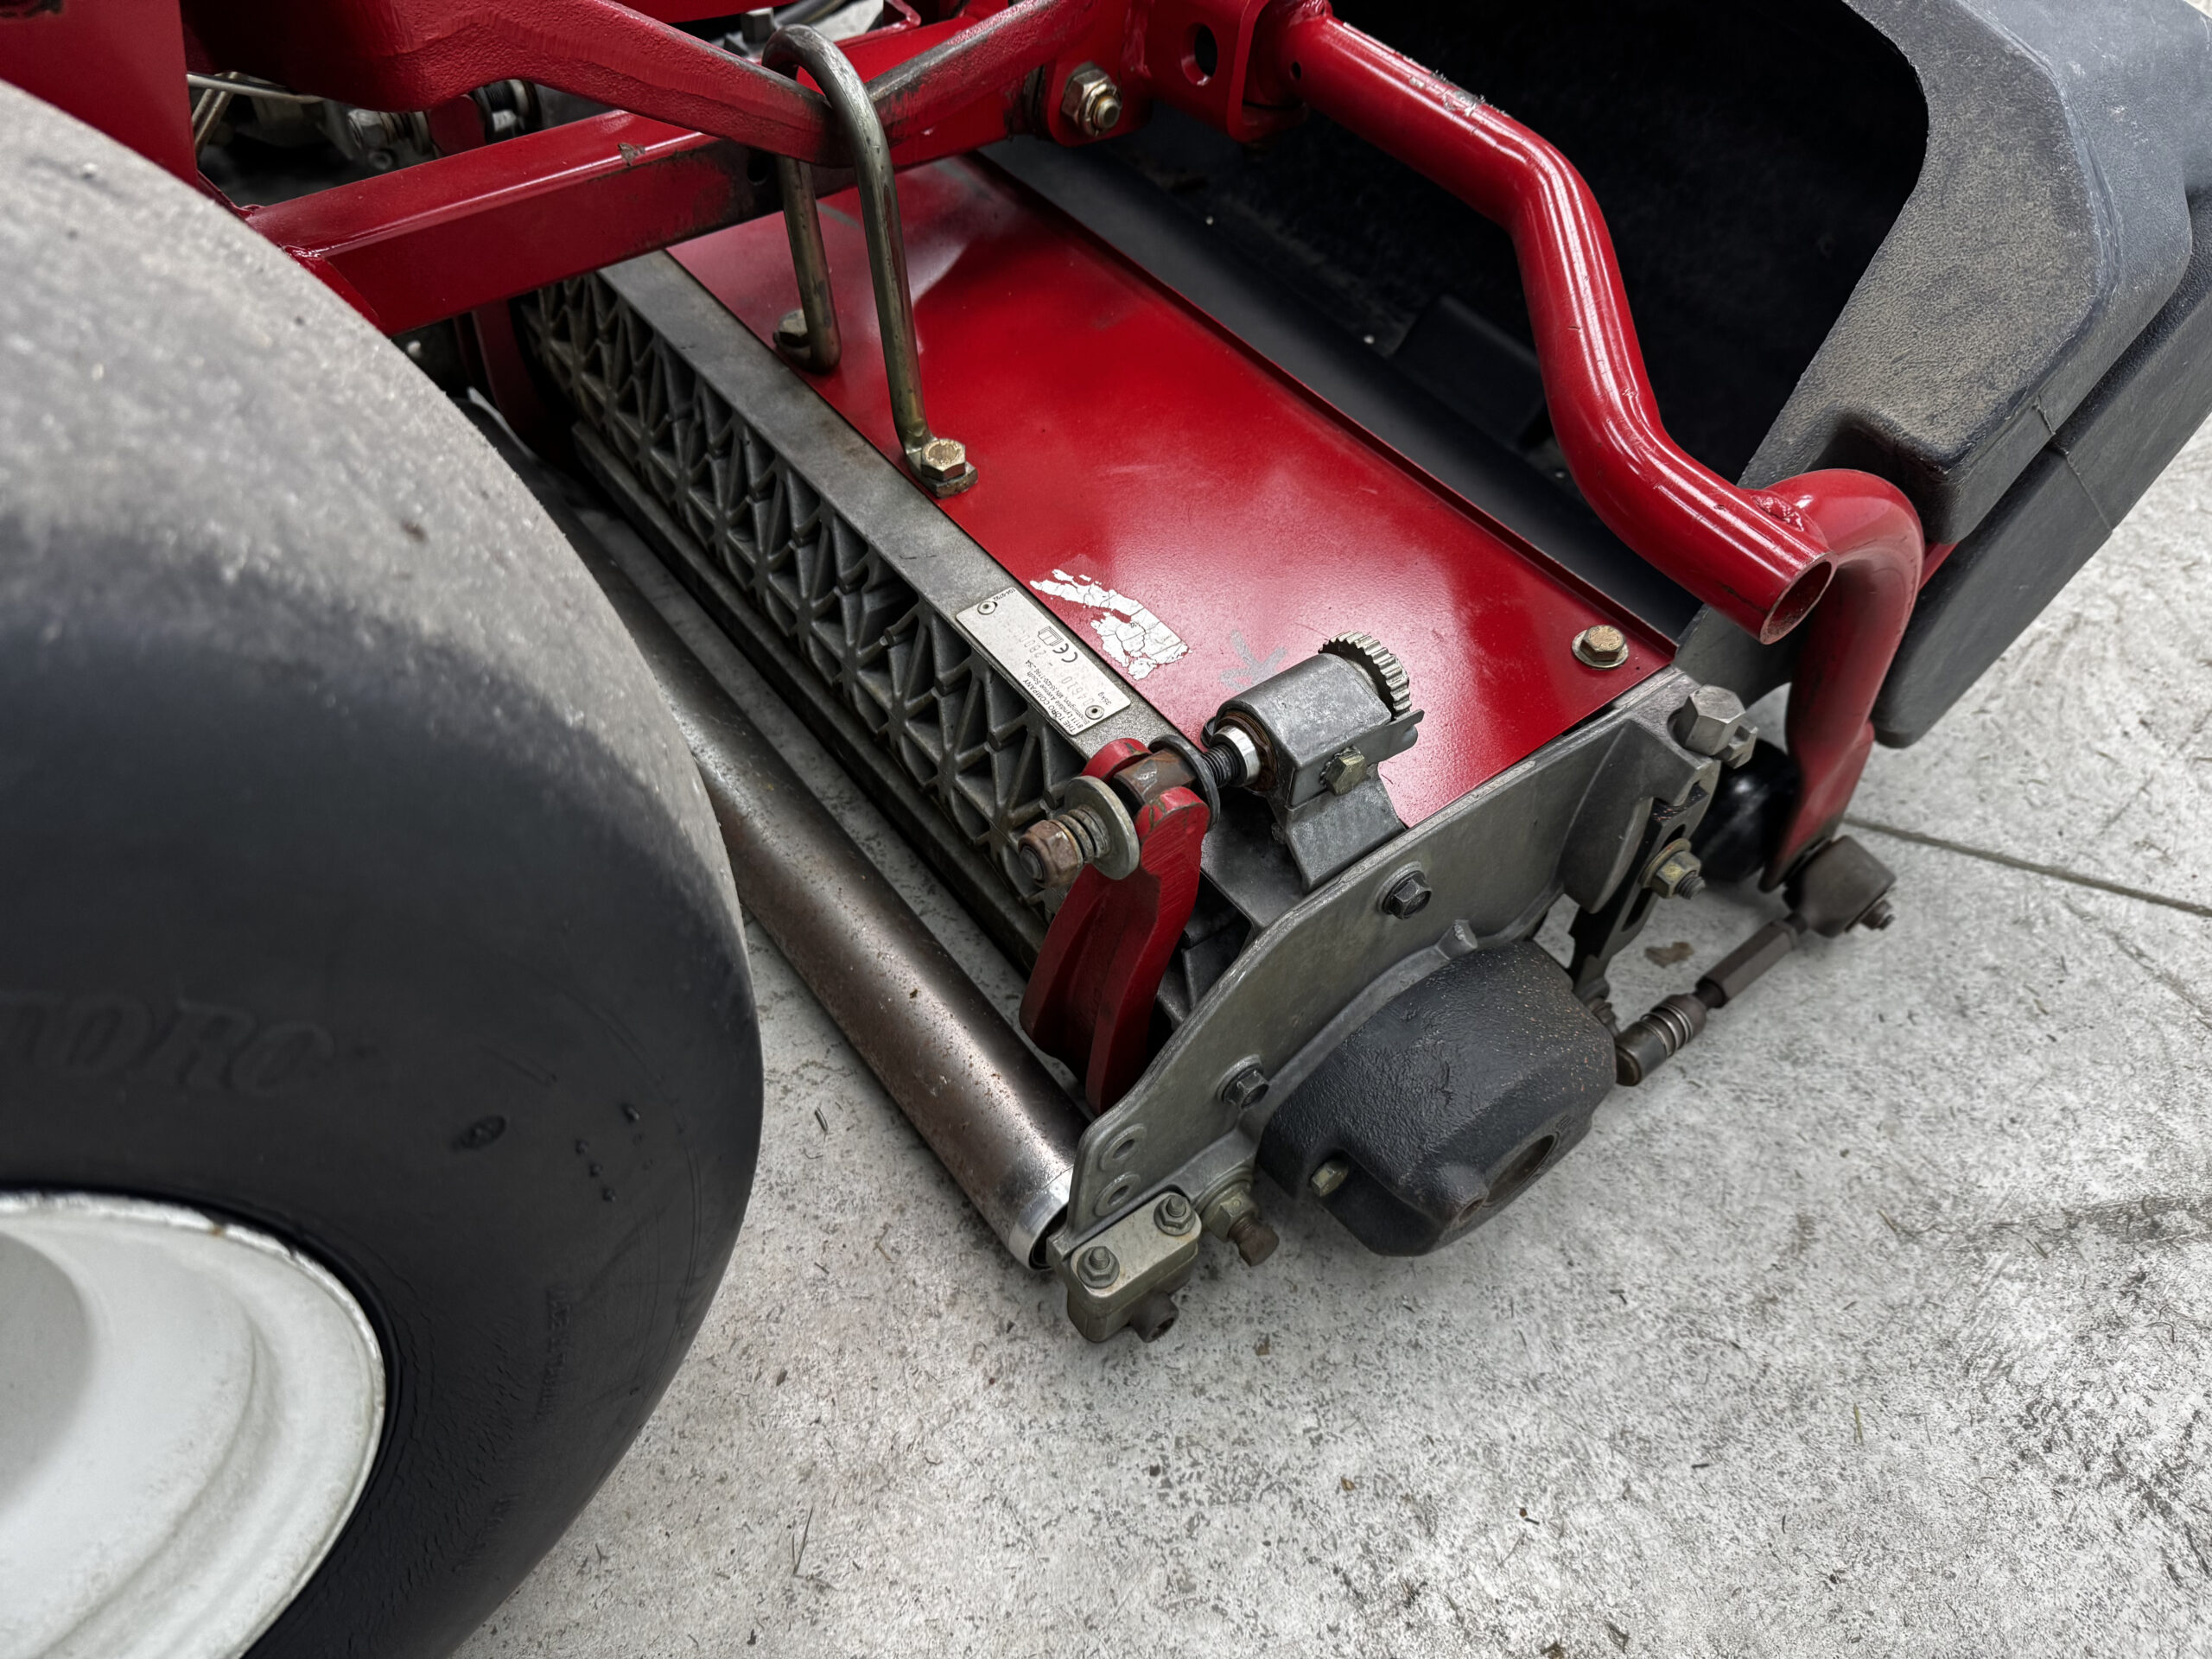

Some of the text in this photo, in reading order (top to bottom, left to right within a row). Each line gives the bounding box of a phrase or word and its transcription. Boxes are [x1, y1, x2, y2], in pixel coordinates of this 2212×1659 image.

[1026, 670, 1041, 685] South
[1039, 683, 1058, 701] Avenue
[1097, 690, 1112, 706] 35kg
[1023, 679, 1077, 733] THE TORO COMPANY
[1054, 699, 1073, 719] Lyndale
